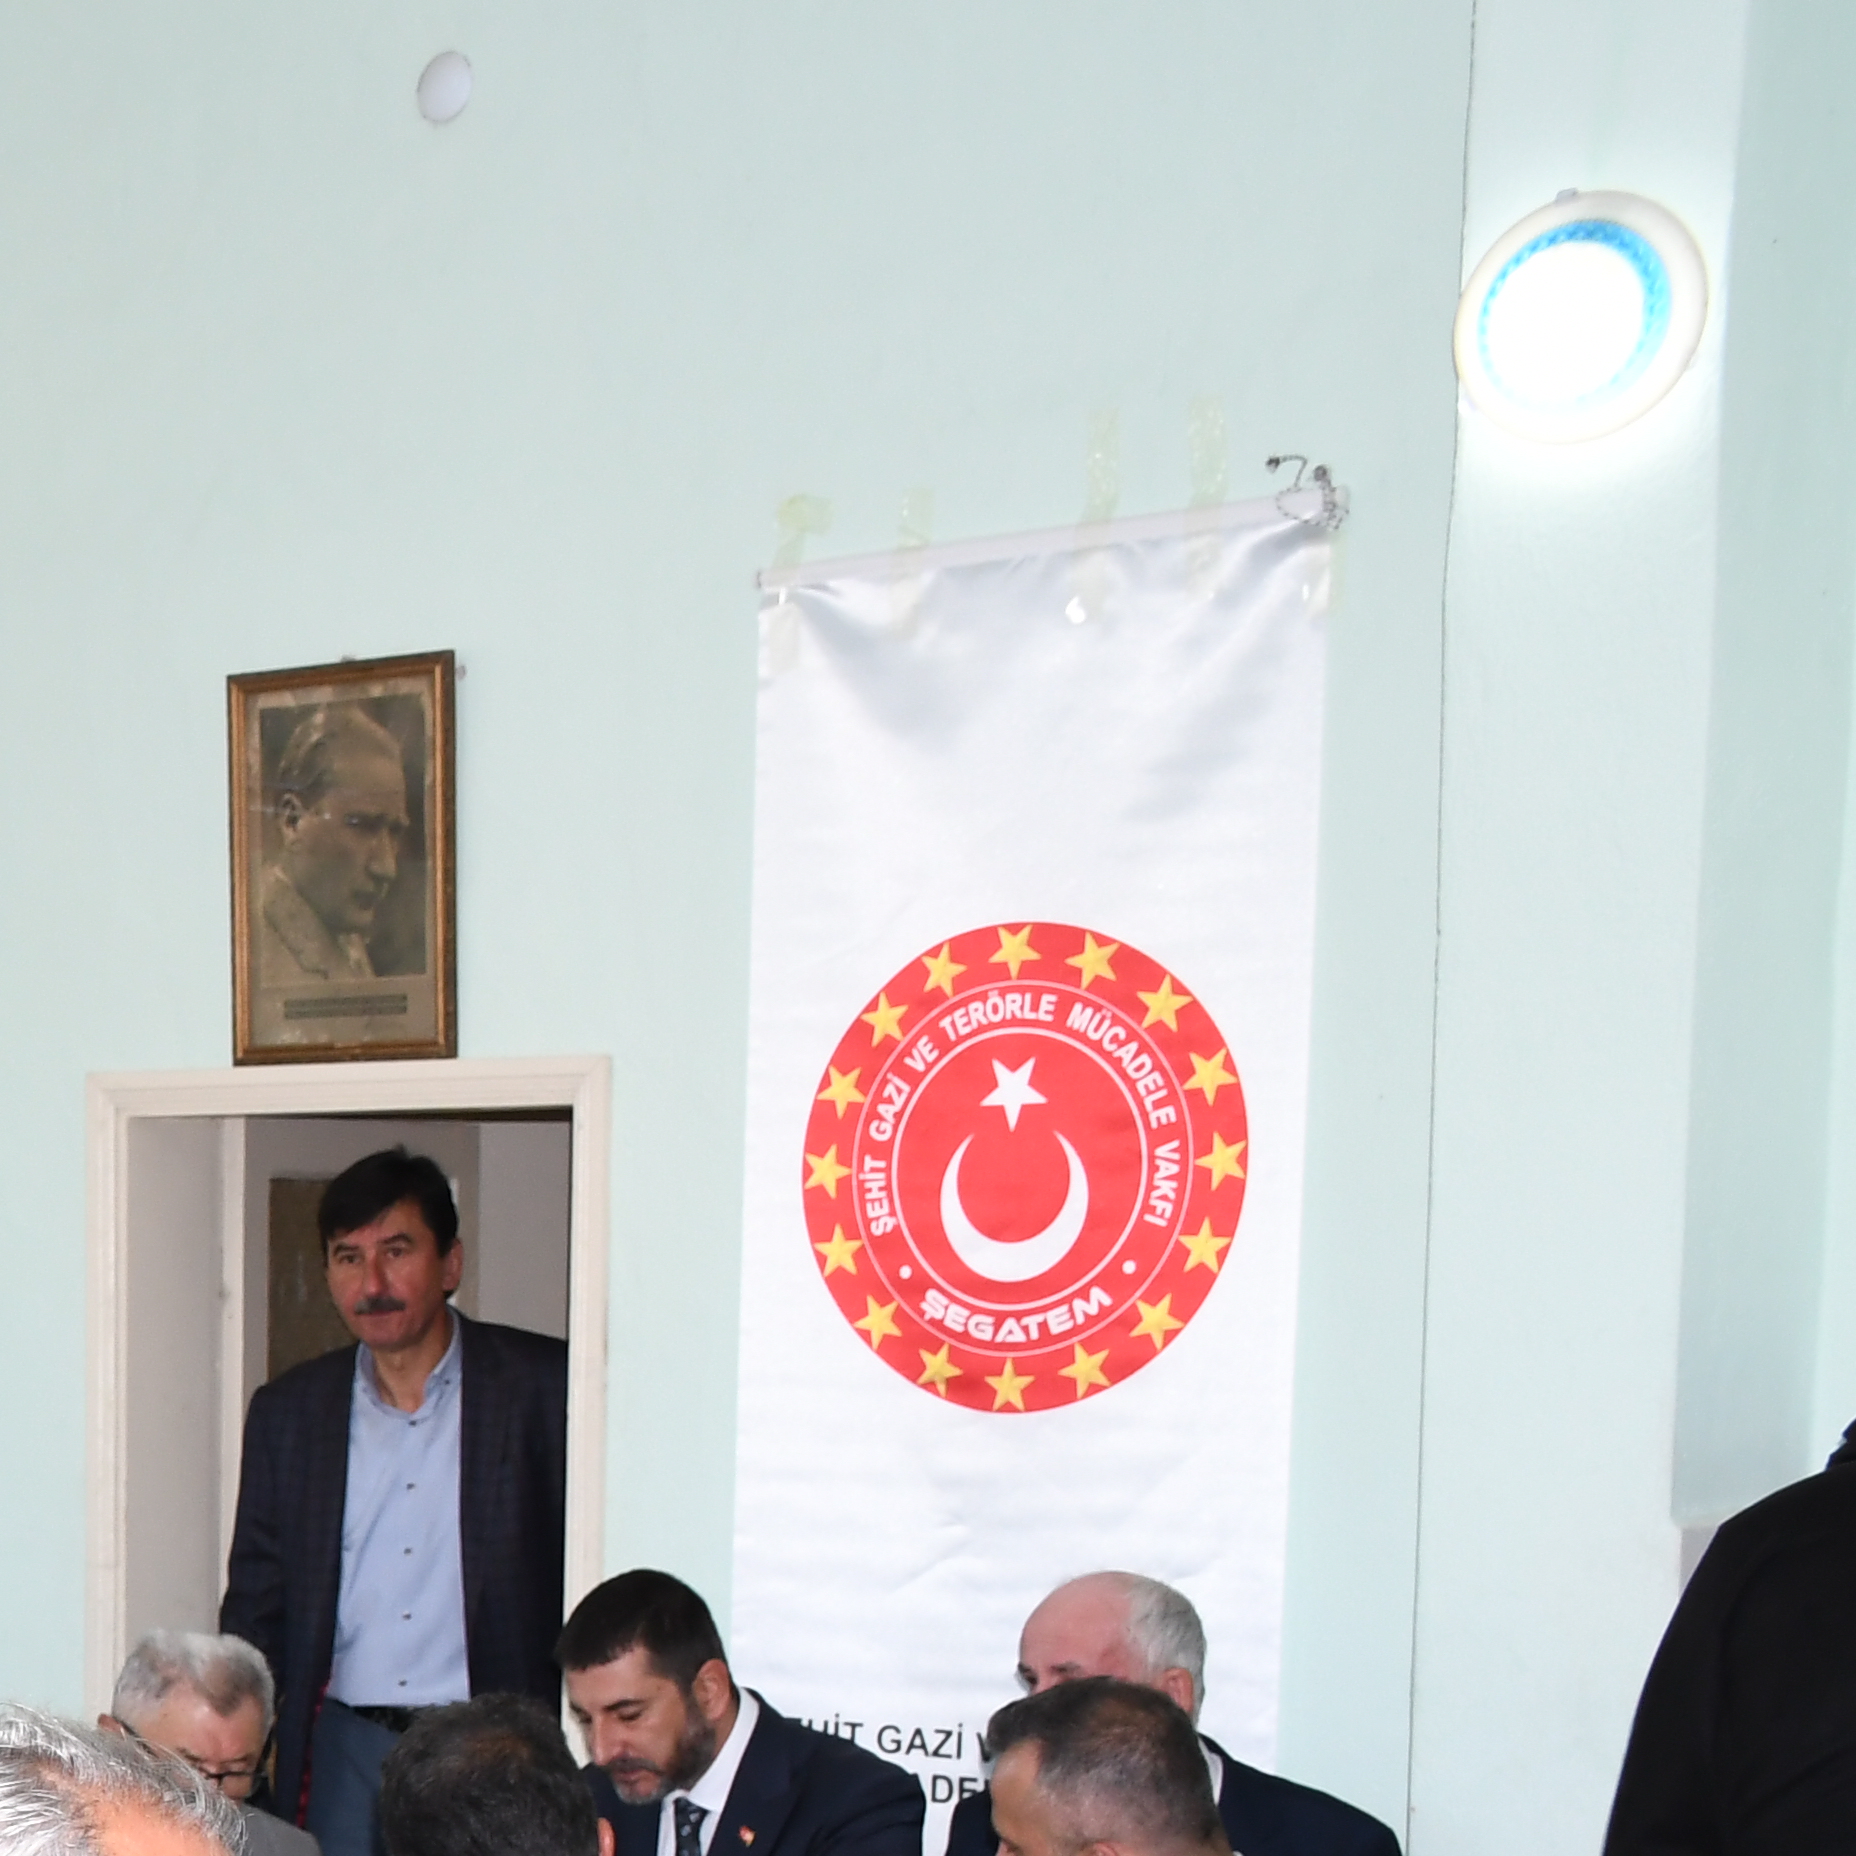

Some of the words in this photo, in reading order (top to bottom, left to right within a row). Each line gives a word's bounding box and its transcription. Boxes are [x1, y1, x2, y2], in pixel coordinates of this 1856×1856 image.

[939, 990, 1058, 1042] TERÖRLE
[903, 1035, 940, 1074] VE
[1065, 1001, 1177, 1130] MÜCADELE
[869, 1072, 910, 1142] GAZİ
[858, 1153, 899, 1237] ŞEHİT
[1142, 1139, 1181, 1228] VAKFI
[919, 1285, 1114, 1344] ŞEGATEM
[876, 1722, 964, 1761] GAZİ
